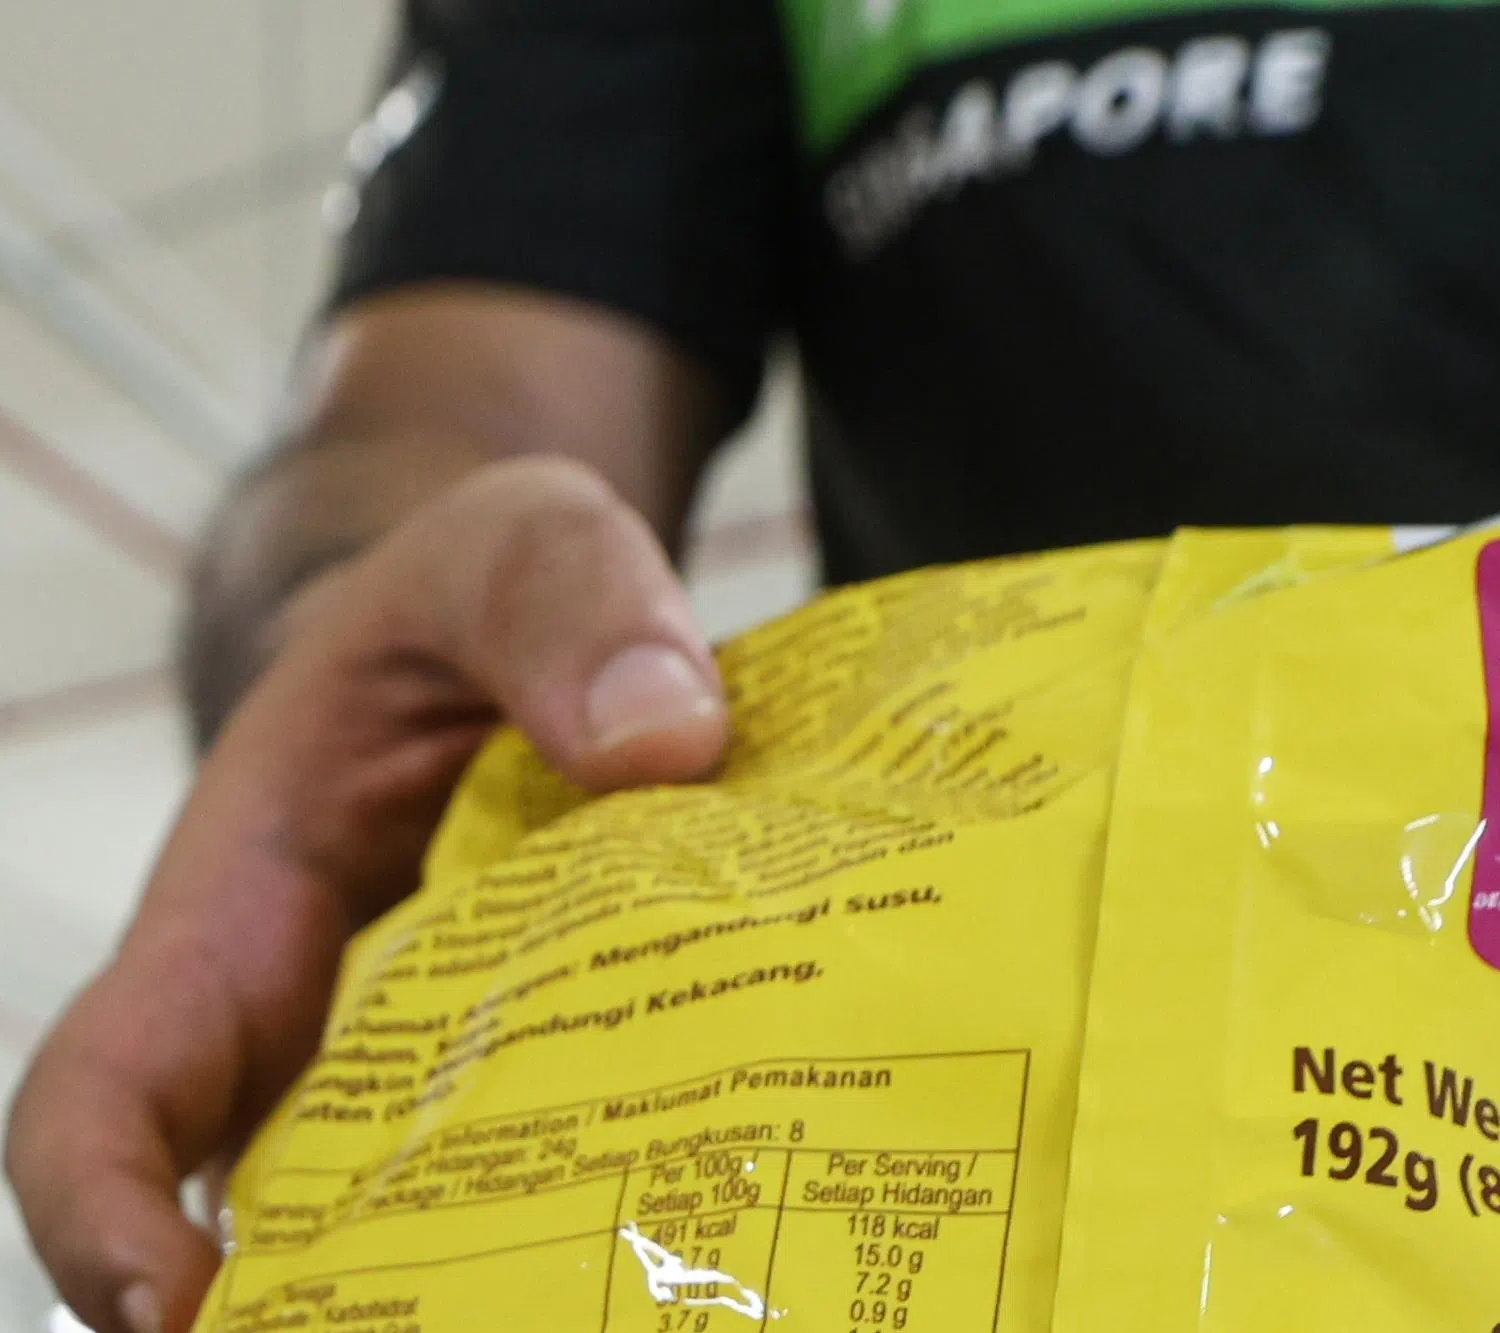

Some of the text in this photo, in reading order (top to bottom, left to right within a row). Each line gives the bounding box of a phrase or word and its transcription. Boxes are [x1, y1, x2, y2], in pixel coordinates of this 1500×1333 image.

[646, 960, 823, 1014] Kekacang,
[602, 1064, 892, 1122] Maklumat Pemakanan
[1292, 1045, 1403, 1106] Net
[644, 1120, 805, 1163] Bungkusan: 8
[827, 1153, 962, 1184] Per Serving
[1293, 1117, 1440, 1212] 192g
[637, 1175, 761, 1220] Setiap 100g
[802, 1181, 992, 1215] Setiap Hidangan
[847, 1214, 941, 1241] 118 kcal
[854, 1272, 892, 1296] 7.2
